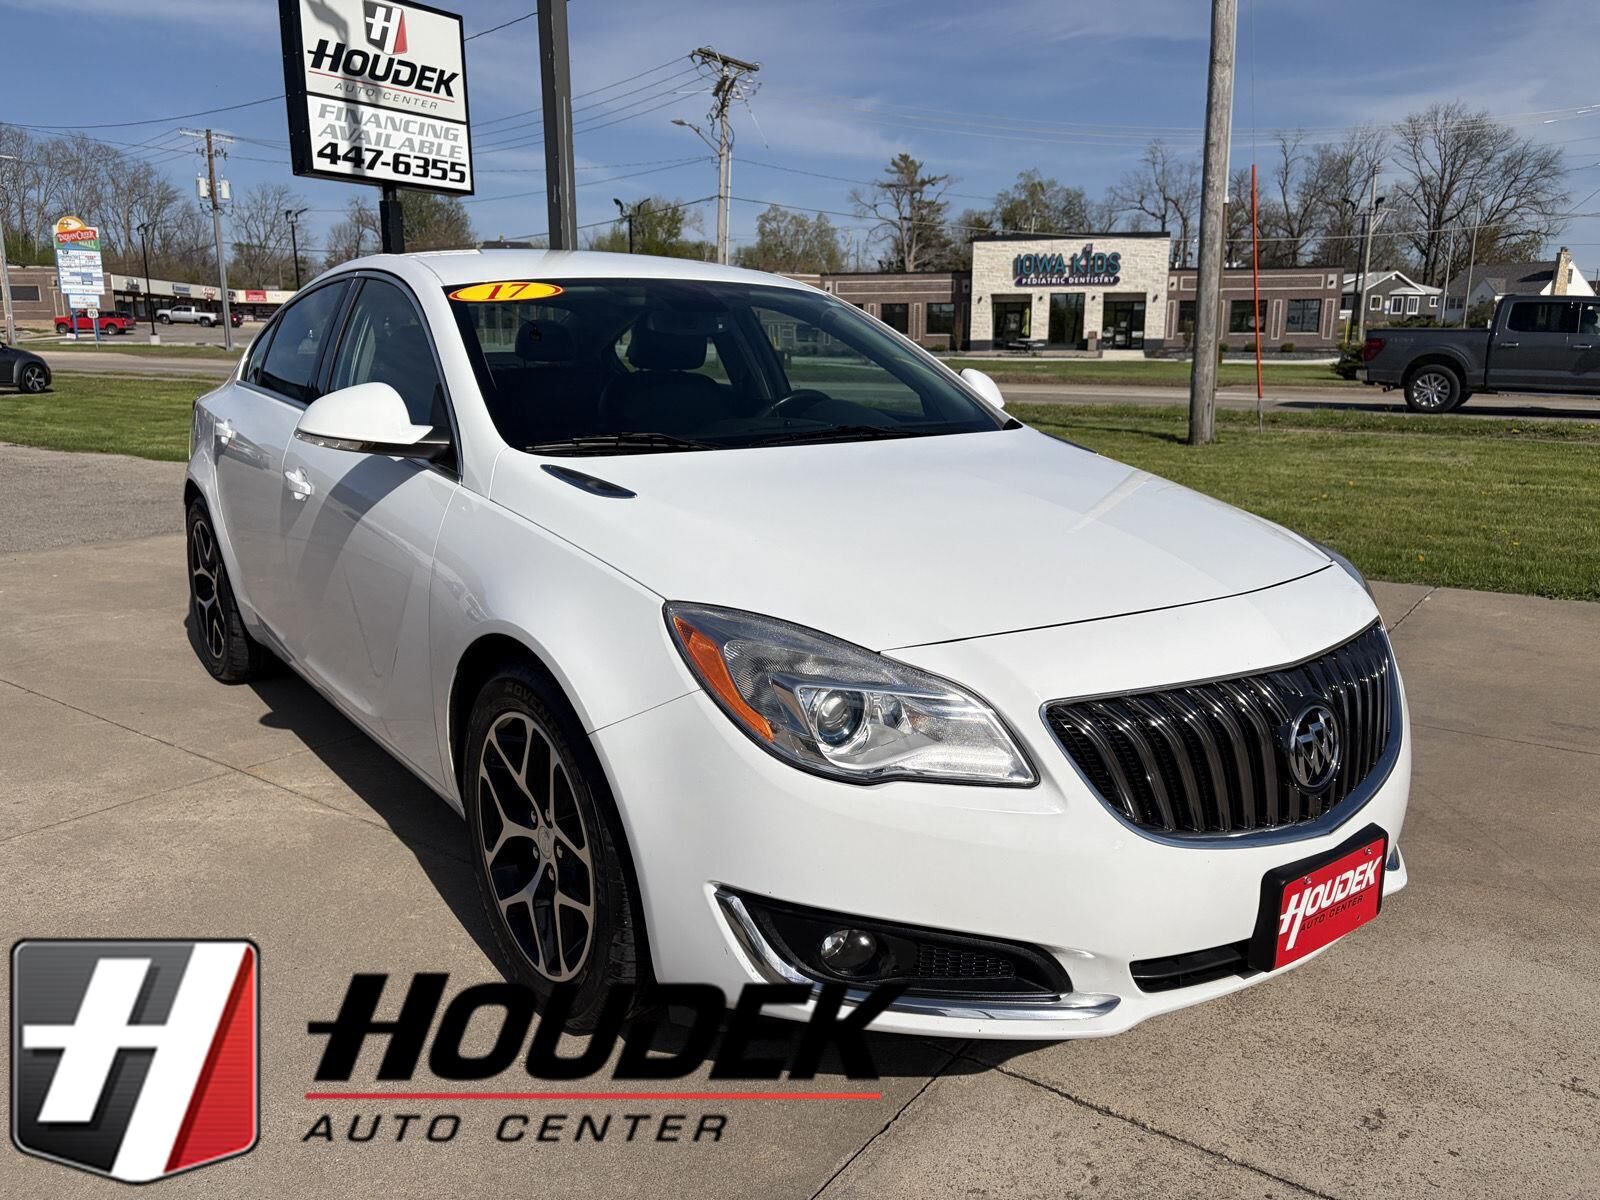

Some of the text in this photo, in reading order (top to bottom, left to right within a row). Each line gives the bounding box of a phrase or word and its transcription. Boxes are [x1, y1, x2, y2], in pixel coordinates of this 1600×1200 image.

[308, 39, 459, 97] HOUDEK
[334, 82, 438, 110] AUTO CENTER
[318, 103, 459, 142] FINANCING
[318, 123, 463, 160] AVAILABLE
[317, 142, 466, 184] 447-6355
[1015, 251, 1121, 275] IOWA KIDS
[1022, 276, 1115, 285] PEDIATRIC DENTISTRY
[482, 283, 530, 300] 17
[1278, 855, 1383, 951] HOUDEK
[1300, 895, 1363, 932] AUTO CENTER
